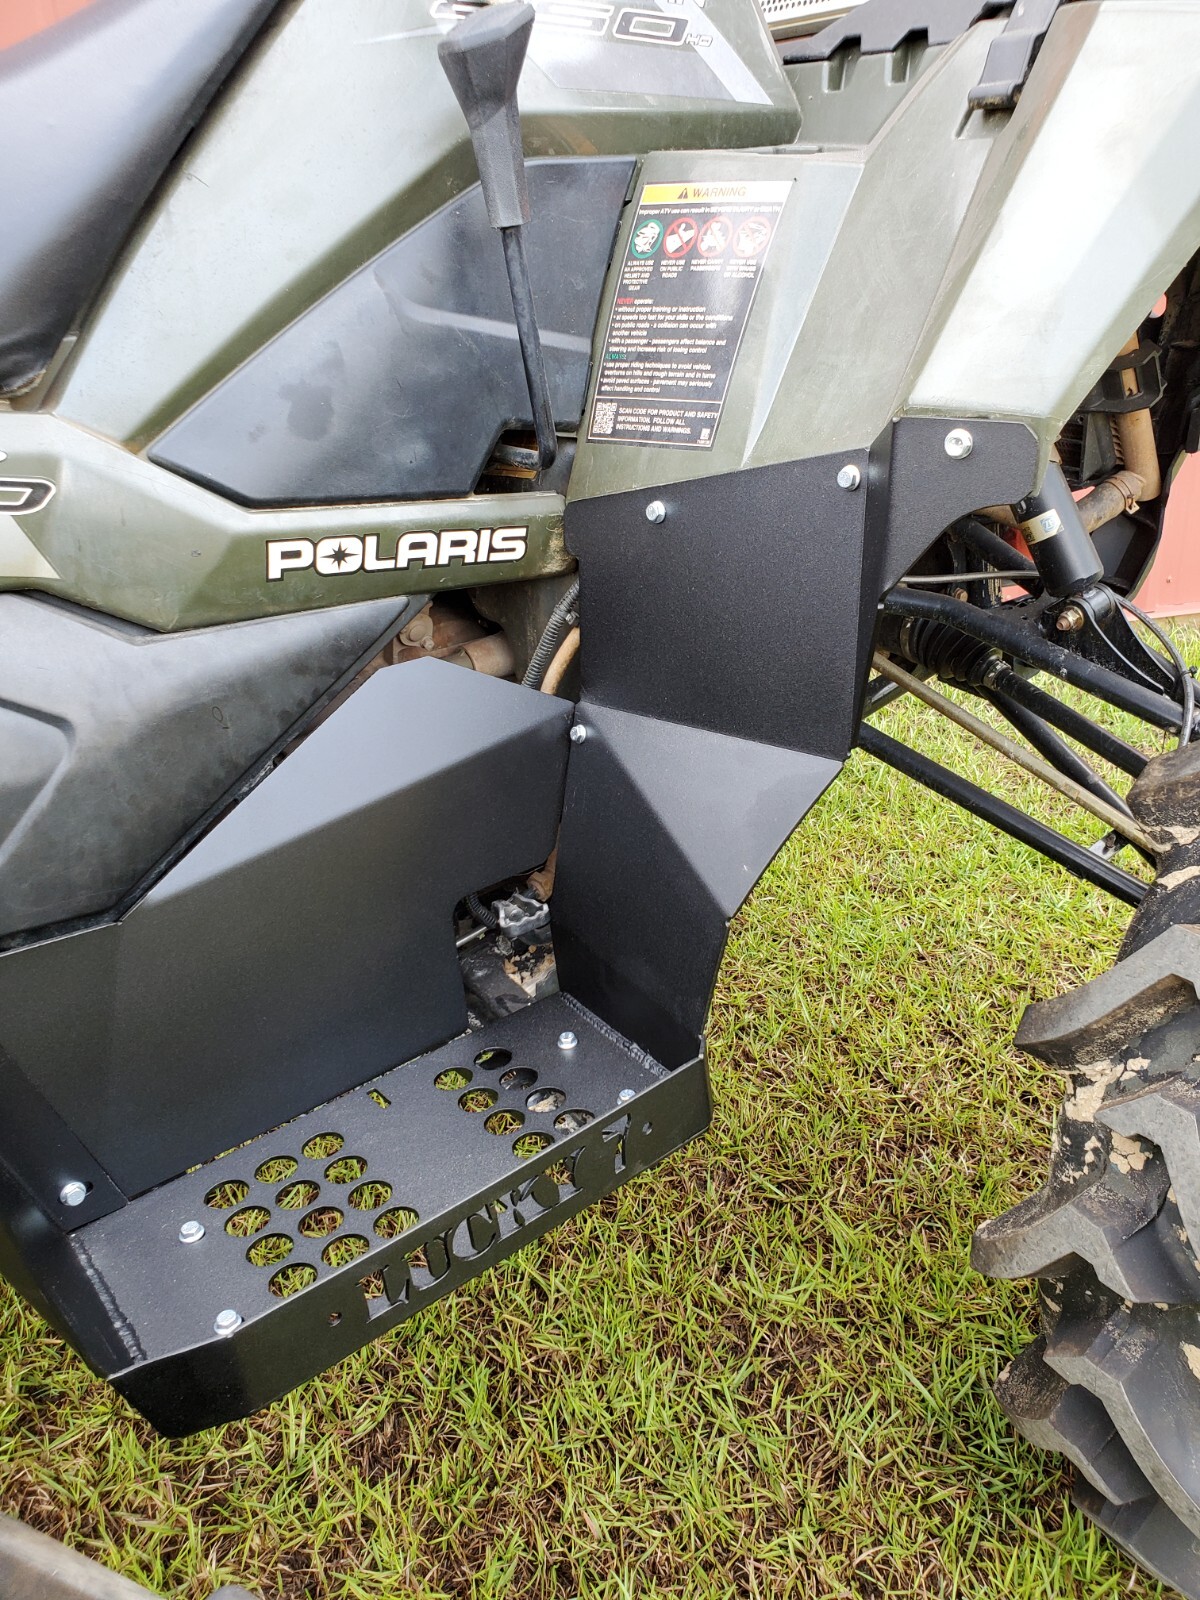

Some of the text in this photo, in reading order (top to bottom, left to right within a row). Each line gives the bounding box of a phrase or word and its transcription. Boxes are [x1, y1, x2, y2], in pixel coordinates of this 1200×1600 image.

[693, 187, 747, 199] WARNING
[630, 362, 644, 370] riding
[689, 380, 714, 388] seriously
[658, 409, 684, 417] PRODUCT
[696, 411, 719, 419] SAFETY
[616, 423, 651, 432] INSTRUCTIONS
[663, 426, 692, 434] WARNINGS.
[266, 526, 529, 582] POLARIS
[356, 1113, 631, 1323] LUCKY 7
